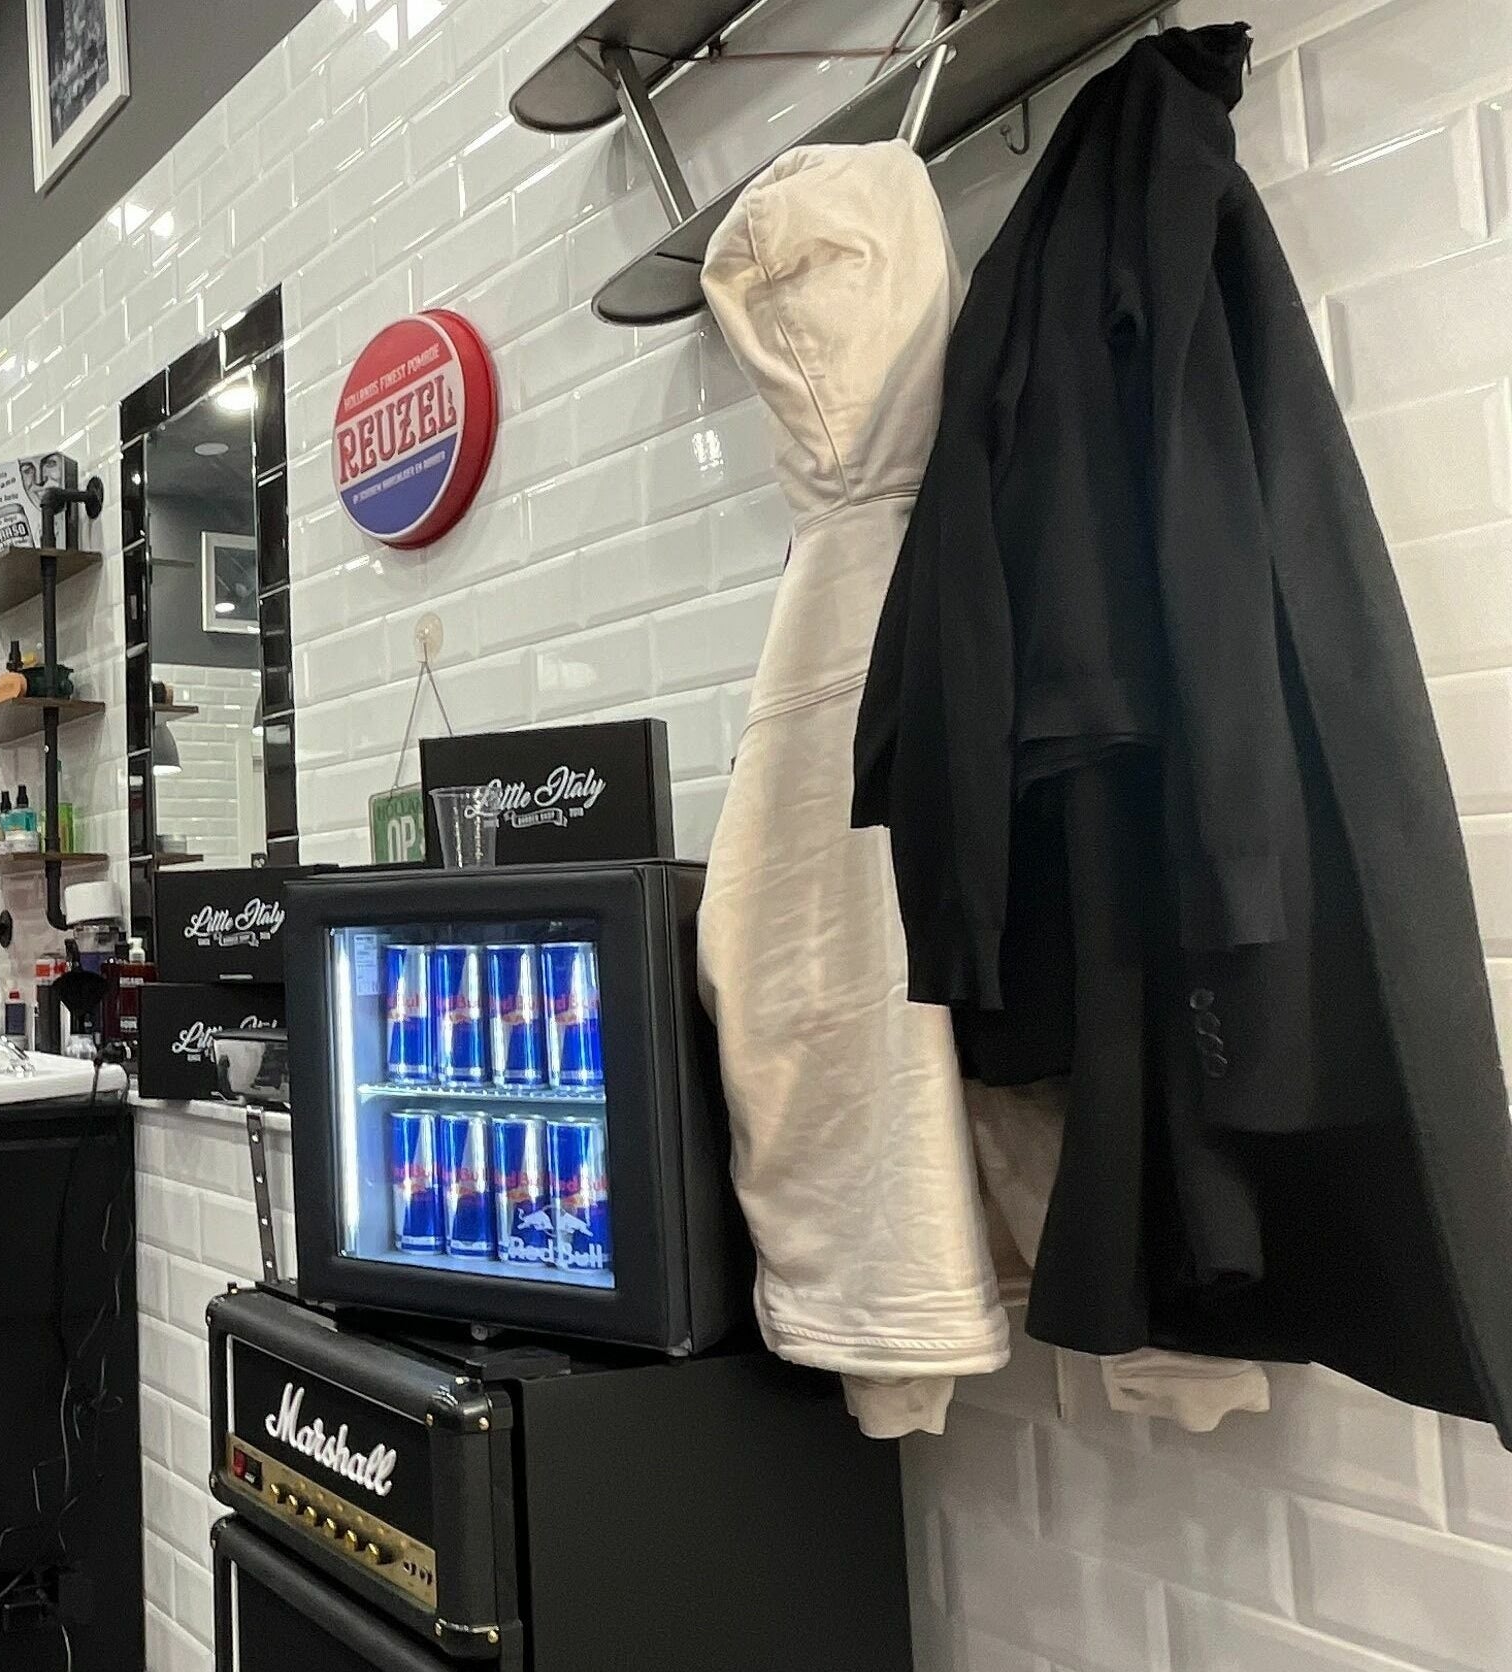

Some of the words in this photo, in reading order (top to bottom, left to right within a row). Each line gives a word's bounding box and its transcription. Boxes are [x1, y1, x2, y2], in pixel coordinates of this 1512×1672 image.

[336, 375, 457, 485] REUZEL
[534, 765, 607, 809] Italy
[387, 815, 425, 864] OP
[184, 905, 234, 939] Little
[234, 897, 286, 935] Italy
[508, 1235, 555, 1263] Red
[556, 1241, 604, 1271] Bull
[265, 1382, 397, 1497] Marshall
